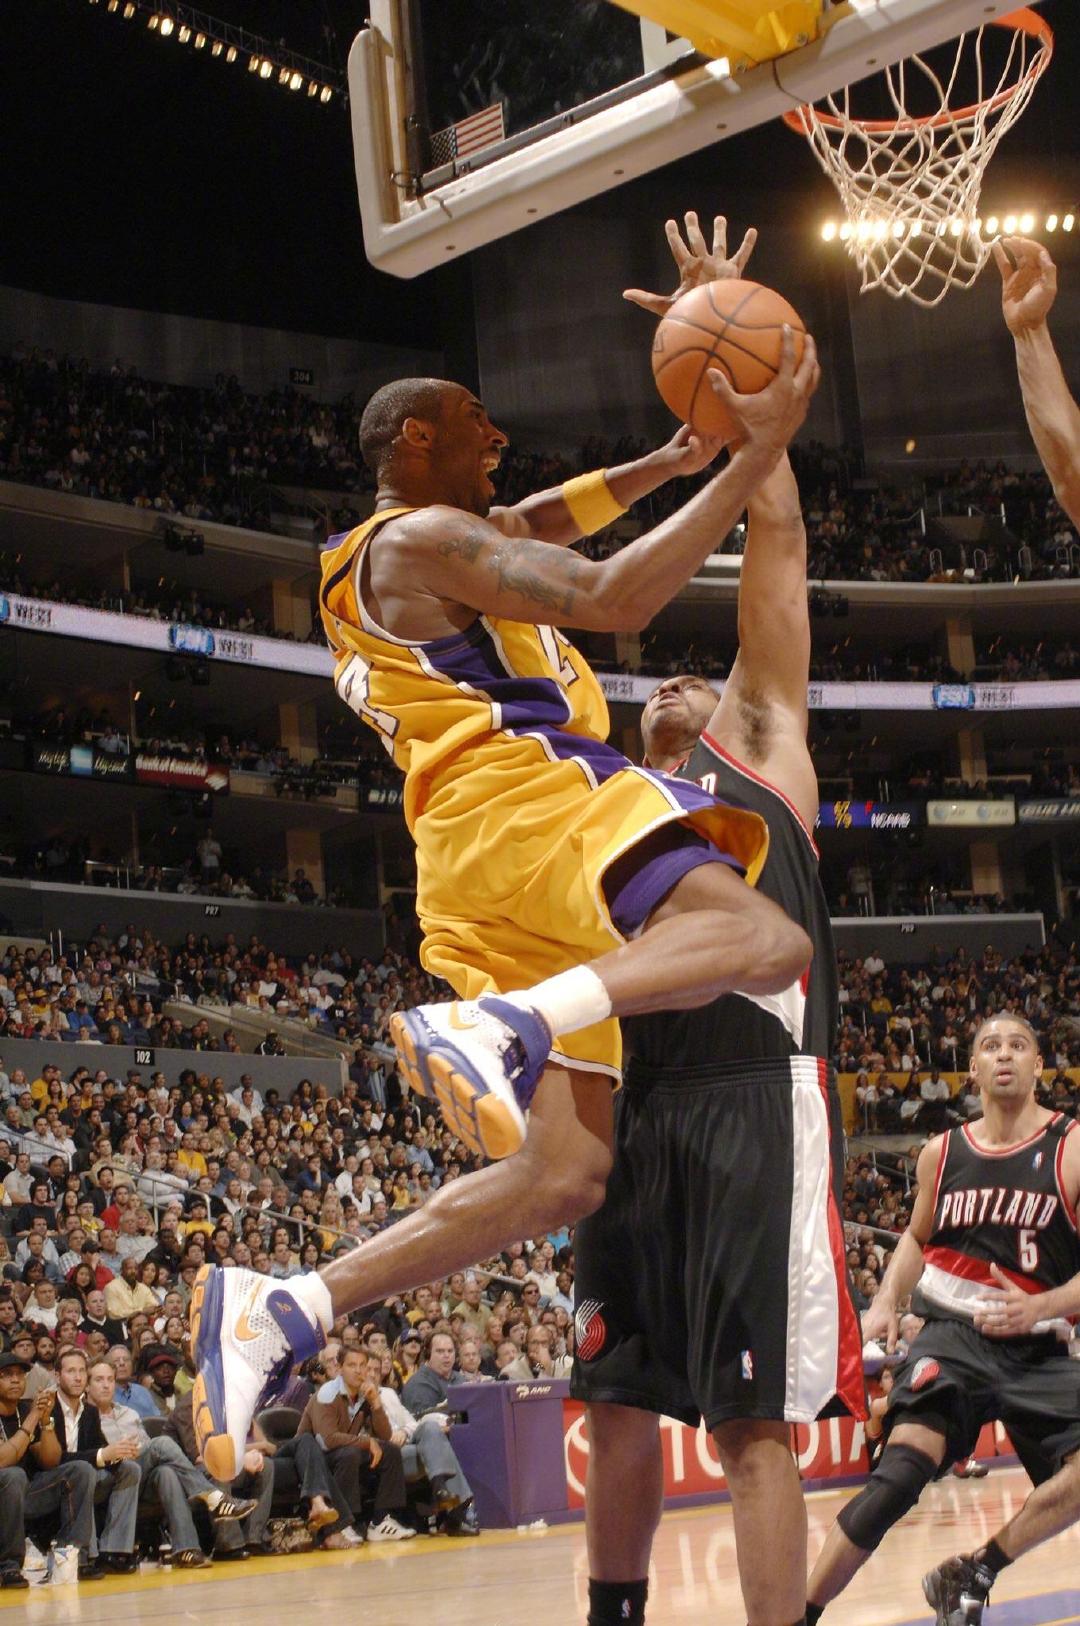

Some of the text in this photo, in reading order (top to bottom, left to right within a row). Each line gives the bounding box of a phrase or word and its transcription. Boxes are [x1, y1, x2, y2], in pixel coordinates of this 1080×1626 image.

[136, 1050, 151, 1064] 102
[938, 1187, 1058, 1231] PORTLAND
[1019, 1229, 1038, 1273] 5
